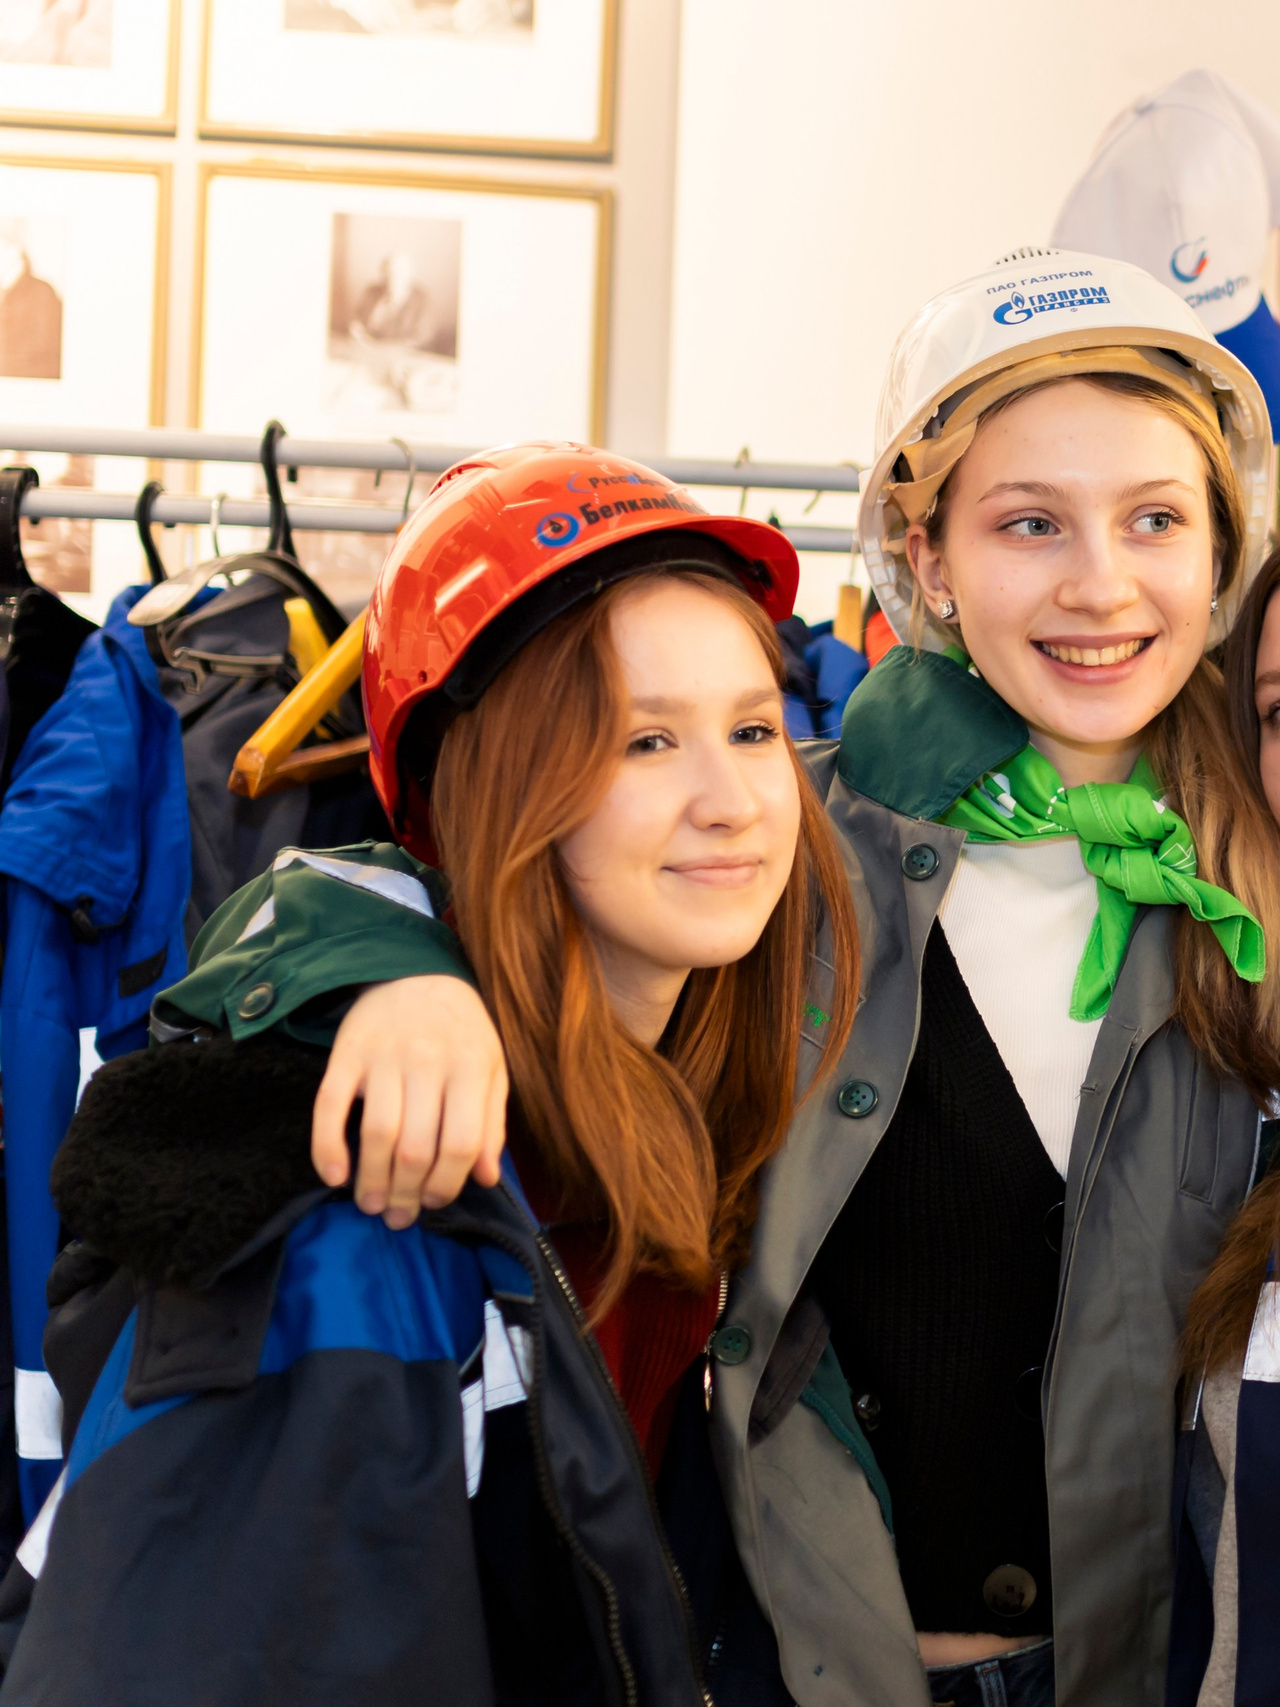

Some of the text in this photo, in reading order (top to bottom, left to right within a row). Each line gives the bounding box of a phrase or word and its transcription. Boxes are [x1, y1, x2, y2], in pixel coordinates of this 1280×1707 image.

[986, 270, 1093, 295] ПАО ГАЗПРОМ
[1028, 286, 1108, 306] ГАЗПРОМ
[1034, 297, 1110, 313] ТРАНСГАЗ
